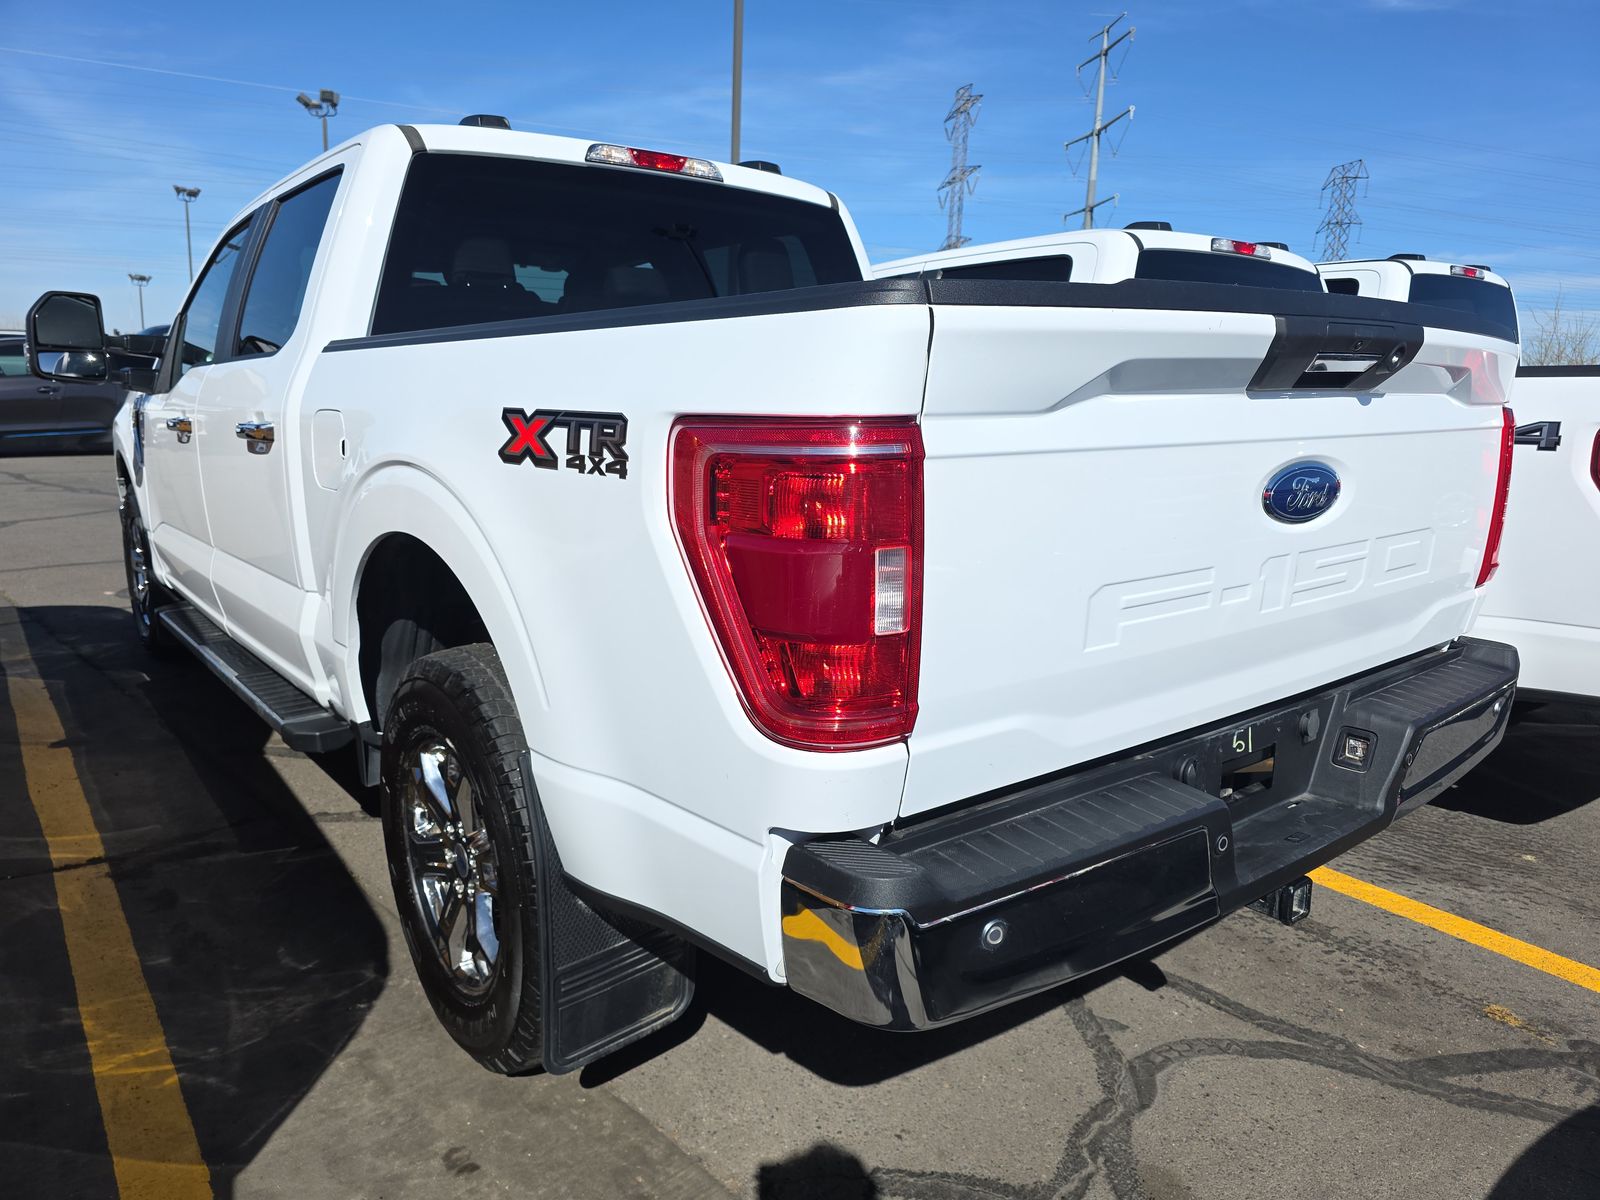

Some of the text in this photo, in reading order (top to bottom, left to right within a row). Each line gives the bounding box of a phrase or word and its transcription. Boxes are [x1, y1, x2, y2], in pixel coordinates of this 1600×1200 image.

[498, 406, 629, 470] XTR
[1286, 476, 1329, 511] Ford
[1083, 526, 1437, 653] F-150
